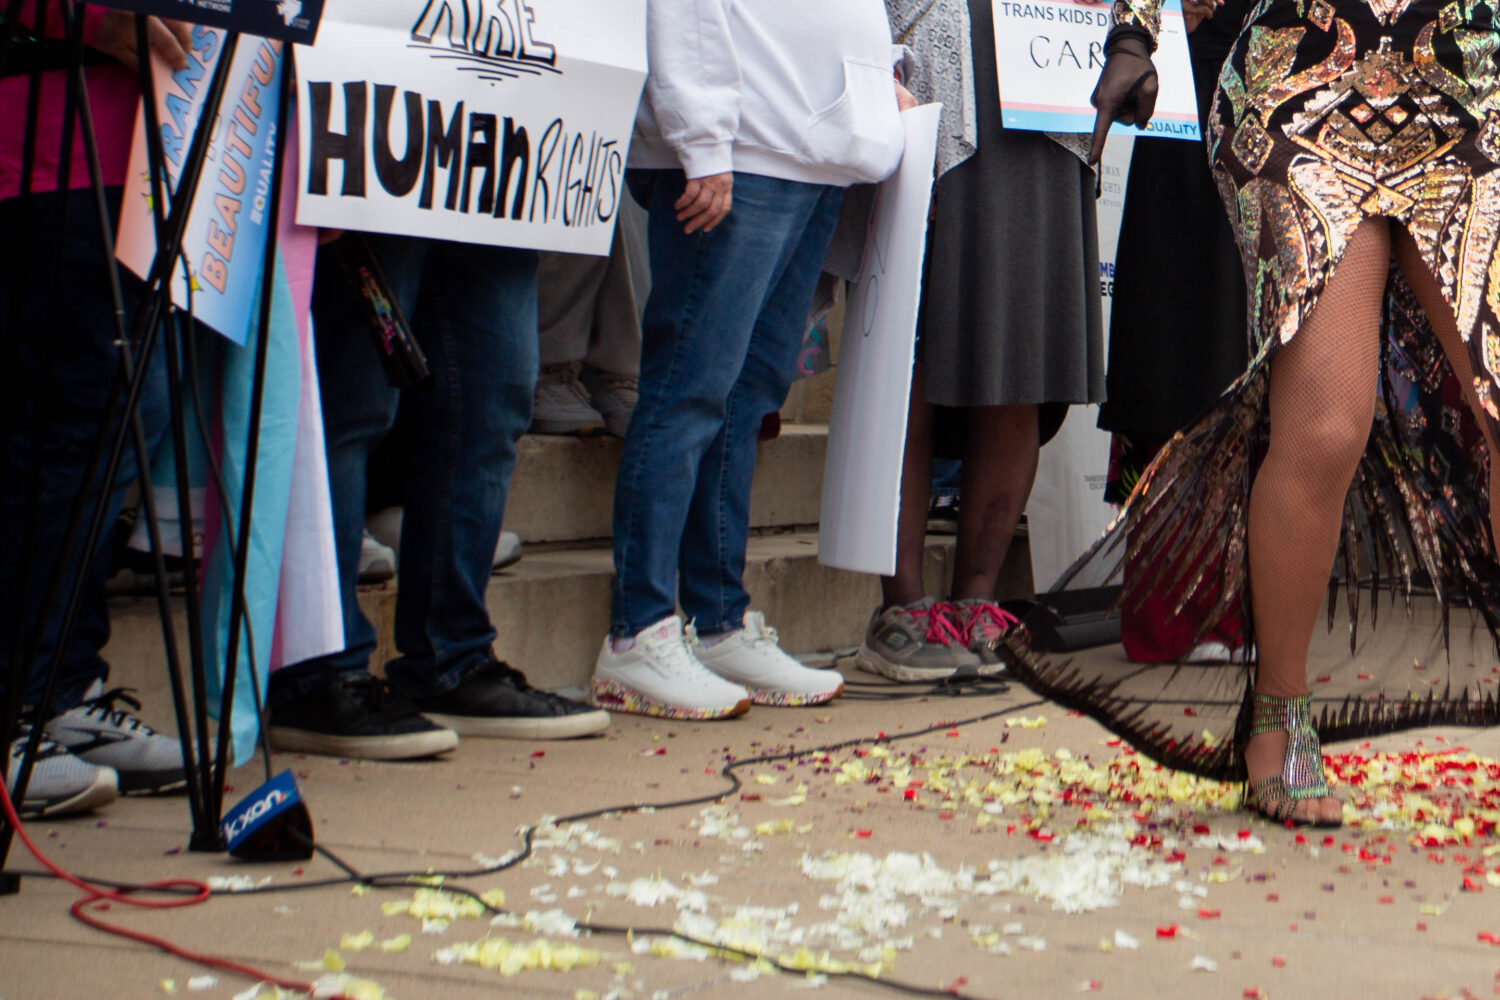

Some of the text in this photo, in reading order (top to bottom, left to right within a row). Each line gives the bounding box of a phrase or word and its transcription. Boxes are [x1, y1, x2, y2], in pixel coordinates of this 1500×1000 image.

[1002, 2, 1054, 21] TRANS
[1058, 8, 1093, 26] KIDS
[1030, 35, 1105, 70] CAR
[159, 25, 220, 167] RANS
[251, 121, 277, 225] EQUALITY
[528, 117, 622, 228] RIGHTS
